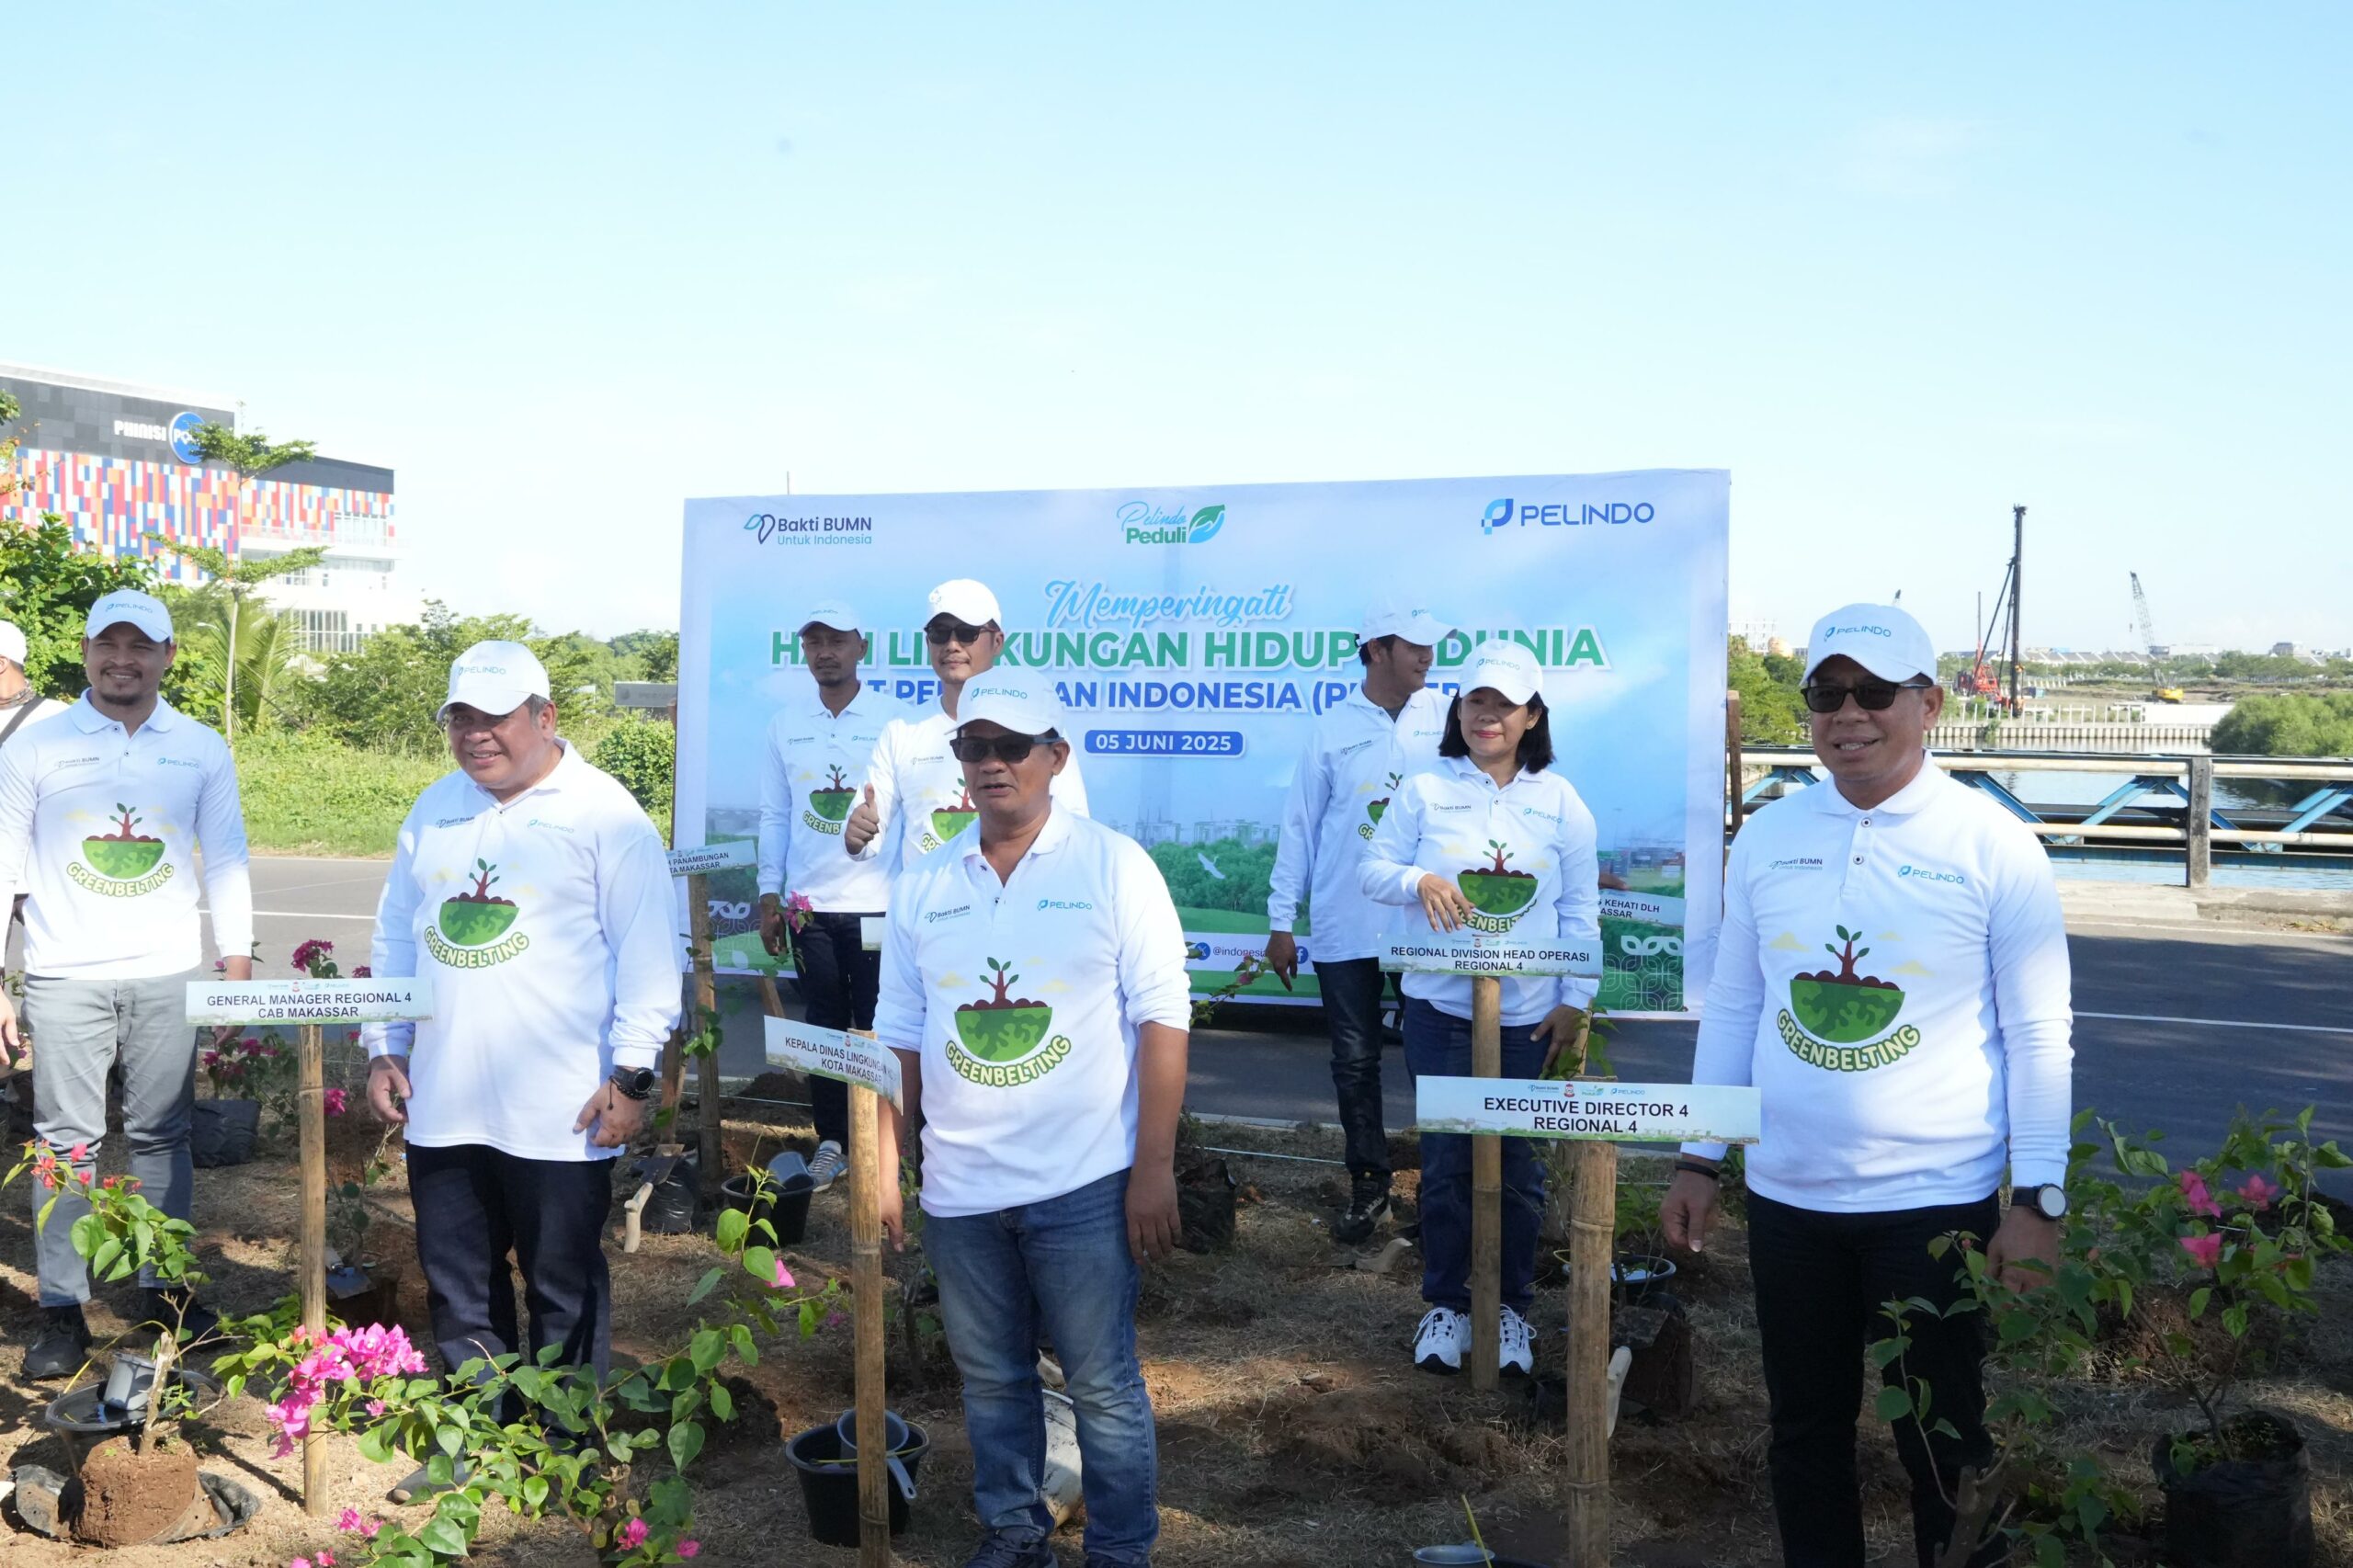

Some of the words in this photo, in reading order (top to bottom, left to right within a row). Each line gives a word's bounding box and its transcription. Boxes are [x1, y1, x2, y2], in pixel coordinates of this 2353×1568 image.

[114, 420, 167, 441] PHINISI
[1117, 501, 1187, 531] Pelindo
[1520, 502, 1654, 527] PELINDO
[778, 517, 819, 532] Bakti
[824, 517, 872, 531] BUMN
[778, 535, 811, 545] Untuk
[813, 534, 872, 545] Indonesia
[1126, 527, 1187, 544] Peduli
[115, 603, 153, 614] PELINDO
[1045, 580, 1290, 629] Memperingati
[1836, 625, 1892, 638] PELINDO
[889, 631, 1188, 667] LIKUNGAN
[1204, 631, 1360, 667] HIDUP
[464, 666, 506, 675] PELINDO
[1485, 659, 1520, 671] PELINDO
[981, 687, 1028, 699] PELINDO
[1108, 681, 1302, 709] INDONESIA
[1096, 734, 1120, 751] 05
[1125, 734, 1174, 751] JUNI
[1181, 735, 1232, 751] 2025
[1532, 810, 1563, 824] PELINDO
[673, 852, 729, 865] PANAMBUNGAN
[679, 861, 721, 873] MAKASSAR
[67, 862, 174, 897] GREENBELTING
[1912, 869, 1964, 884] PELINDO
[953, 904, 971, 915] BUMN
[1050, 902, 1092, 910] PELINDO
[1605, 898, 1639, 910] KEHATI
[1641, 903, 1660, 913] DLH
[424, 926, 529, 969] GREENBELTING
[1391, 946, 1448, 958] REGIONAL
[1451, 949, 1500, 960] DIVISION
[1504, 949, 1535, 960] HEAD
[1539, 950, 1589, 962] OPERASI
[1454, 960, 1513, 971] REGIONAL
[1517, 961, 1523, 971] 4
[207, 994, 266, 1006] GENERAL
[269, 994, 331, 1006] MANAGER
[332, 993, 401, 1005] REGIONAL
[404, 992, 412, 1003] 4
[258, 1007, 284, 1018] CAB
[288, 1006, 358, 1018] MAKASSAR
[1776, 1008, 1919, 1072] GREENBELTING
[785, 1036, 818, 1053] KEPALA
[819, 1044, 845, 1060] DINAS
[847, 1051, 887, 1074] LINGKUNGAN
[945, 1035, 1071, 1086] GREENBELTING
[821, 1058, 844, 1073] KOTA
[846, 1063, 882, 1085] MAKASSAR
[1483, 1096, 1579, 1114] EXECUTIVE
[1585, 1100, 1674, 1118] DIRECTOR
[1678, 1104, 1688, 1118] 4
[1533, 1117, 1624, 1133] REGIONAL
[1628, 1119, 1638, 1133] 4
